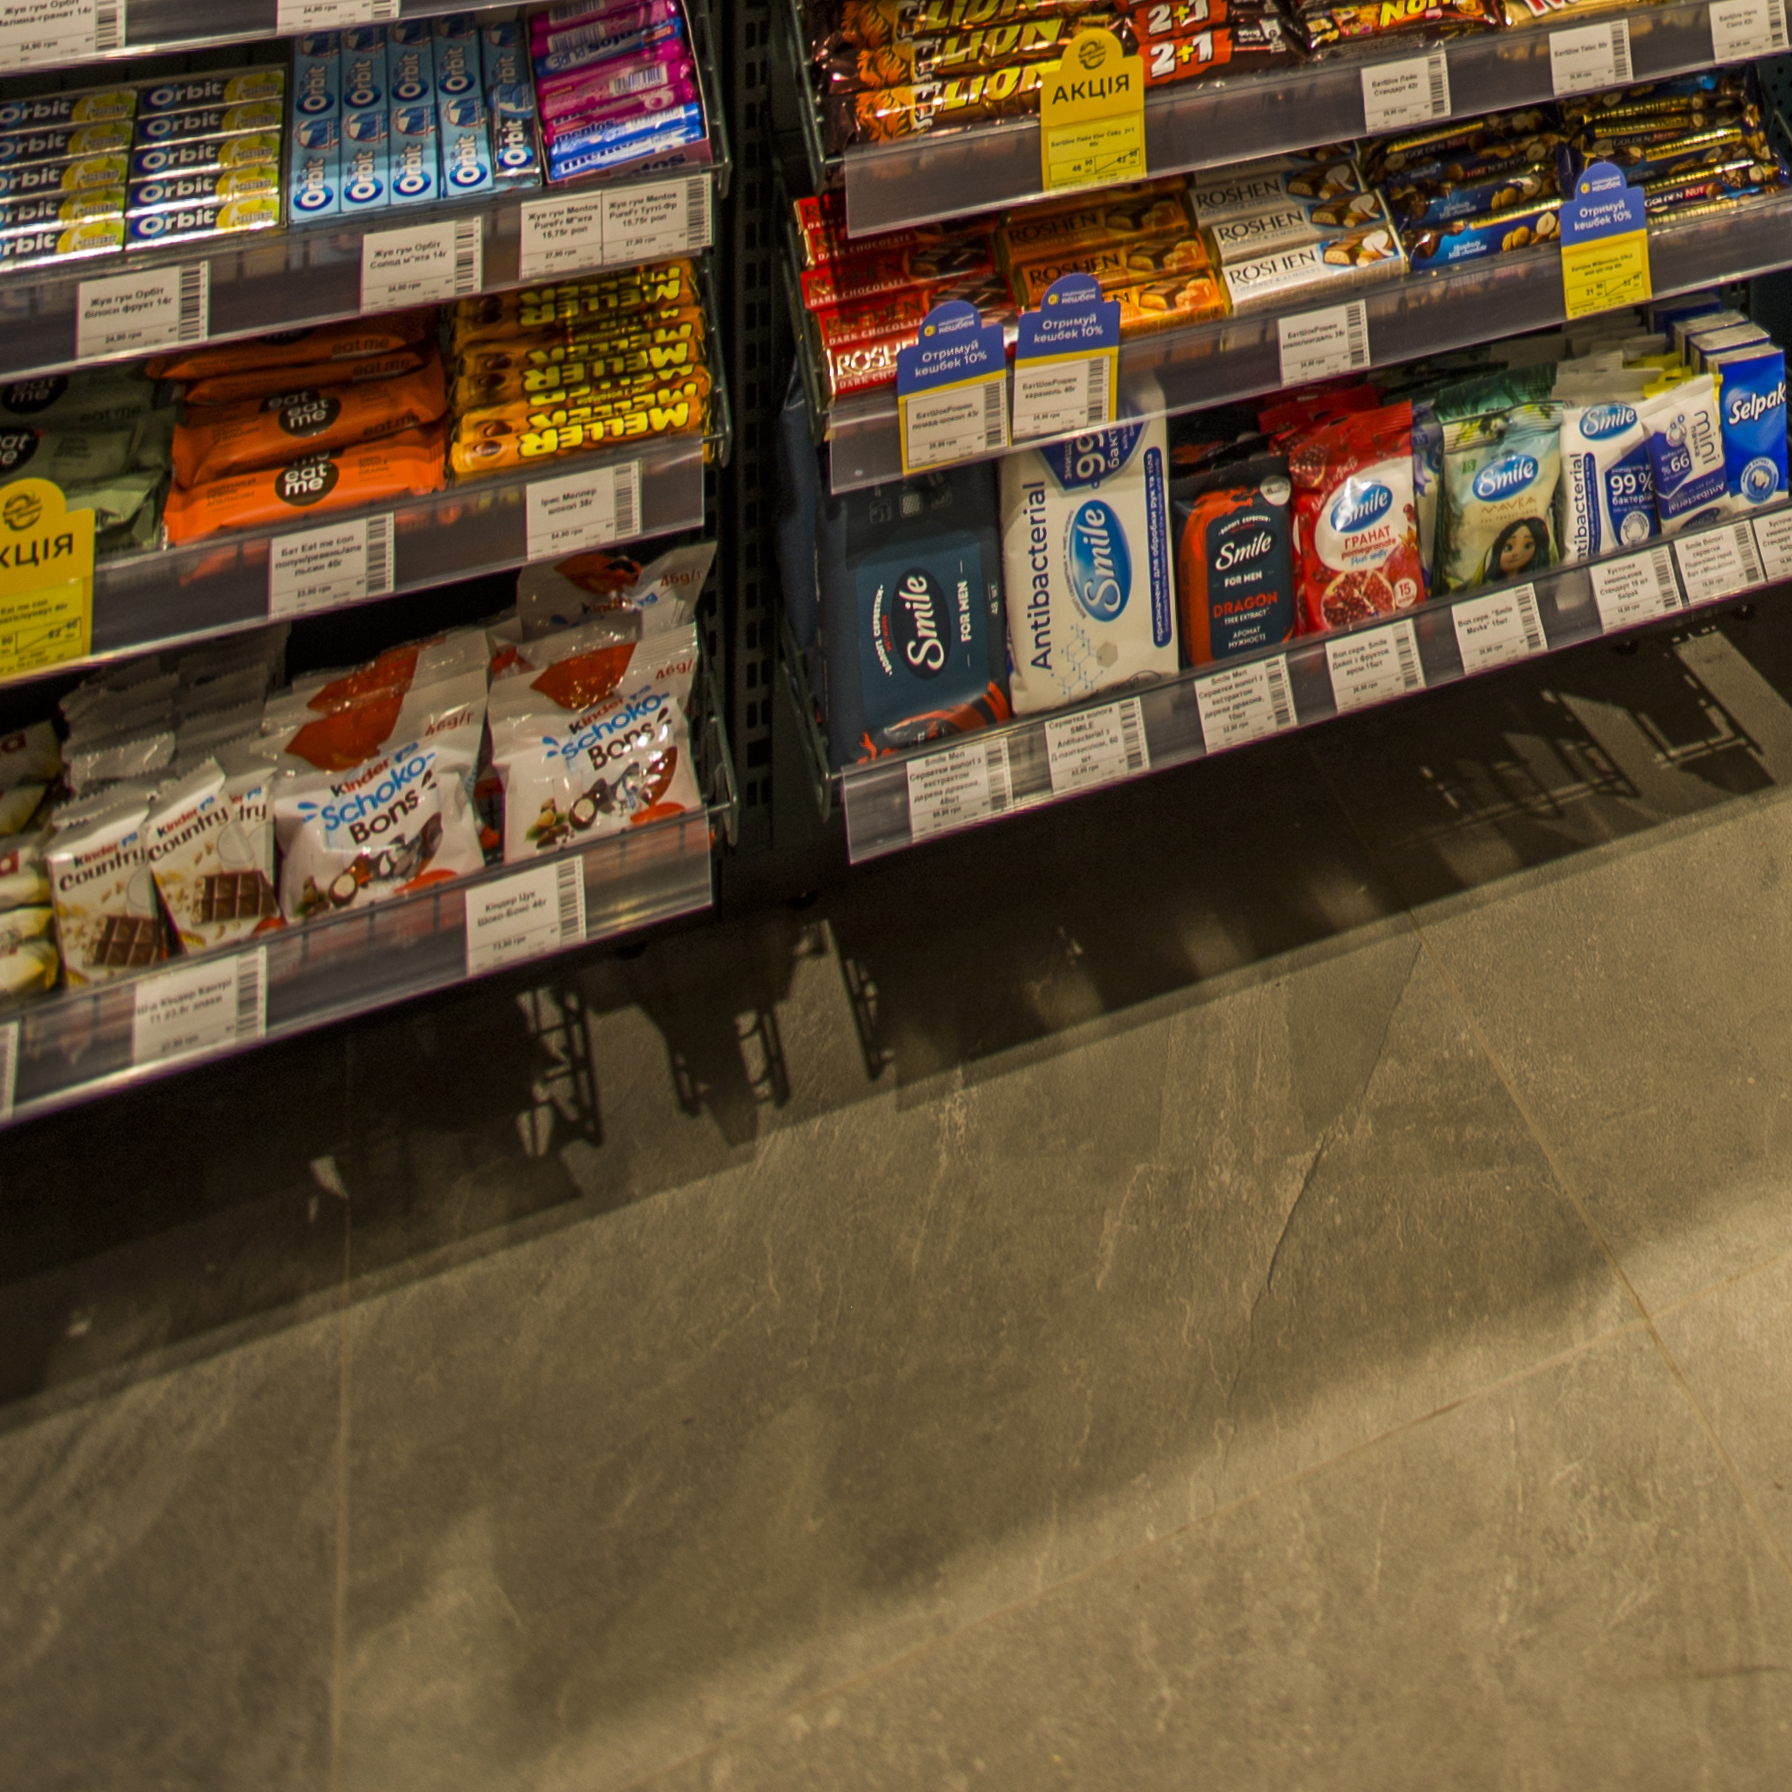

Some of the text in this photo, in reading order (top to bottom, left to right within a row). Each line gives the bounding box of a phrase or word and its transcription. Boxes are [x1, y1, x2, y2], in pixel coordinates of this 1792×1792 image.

[1052, 74, 1131, 105] АКЦІЯ
[1194, 176, 1283, 212] ROSHEN
[1645, 185, 1707, 209] GOLDEN NUT
[1573, 209, 1632, 232] кешбек 10%
[1033, 324, 1104, 344] кешбек 10%
[1042, 313, 1098, 331] Отримуй
[914, 350, 988, 377] кешбек 10%
[921, 339, 980, 364] Отримуй
[1728, 382, 1786, 426] Selpak
[518, 404, 690, 457] MELLER
[1696, 411, 1721, 464] mini
[283, 462, 331, 481] eat
[282, 476, 324, 495] me
[1151, 520, 1161, 556] обробки
[1343, 527, 1392, 548] ГРАНАТ
[1077, 508, 1121, 613] Smile
[1151, 558, 1161, 574] для
[1023, 479, 1052, 671] Antibacterial
[1224, 571, 1262, 588] FOR MEN
[1398, 583, 1412, 596] 15
[957, 580, 973, 643] FOR MEN
[1213, 591, 1278, 618] DRAGON
[1240, 608, 1269, 622] EXTRACT
[905, 574, 945, 670] Smile
[1232, 626, 1261, 639] АРОМАТ
[1228, 635, 1266, 649] МУЖНОСТІ
[321, 751, 435, 832] Schoko-
[347, 788, 420, 846] Bons
[73, 841, 118, 869] kinder
[59, 846, 146, 892] country
